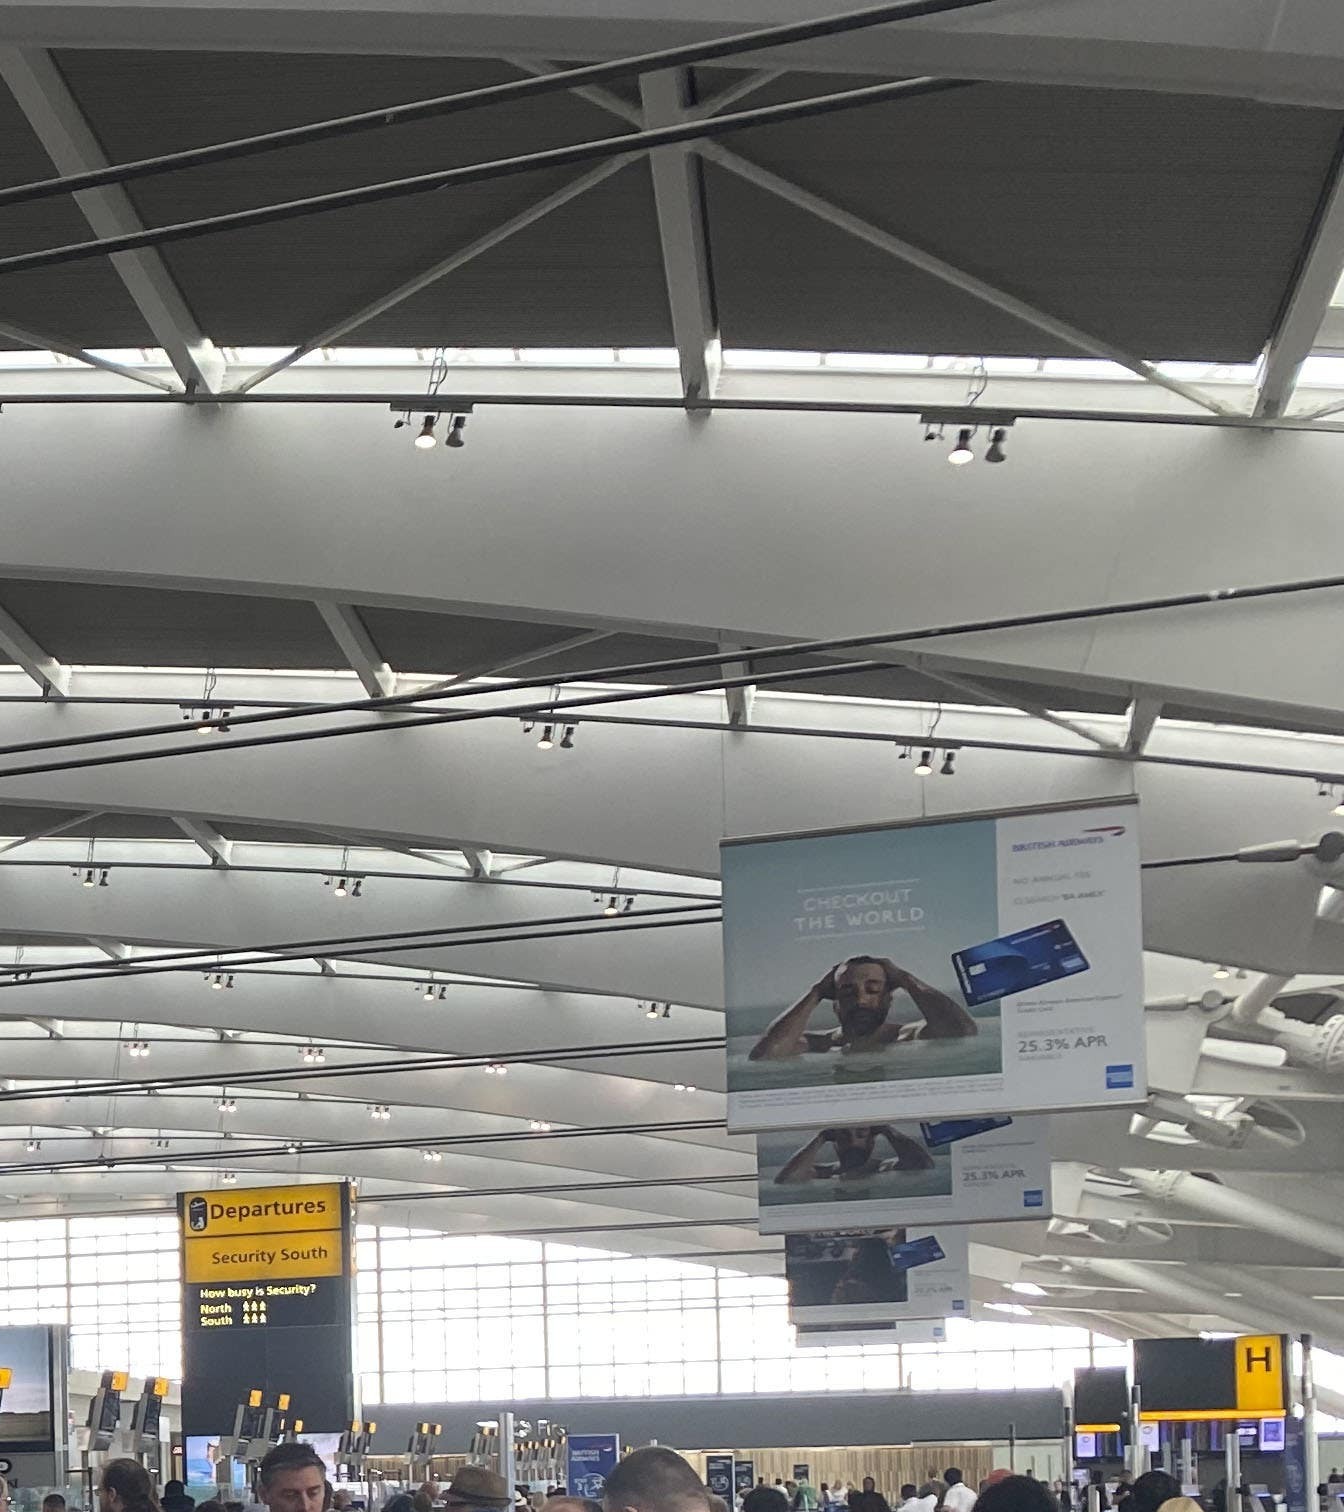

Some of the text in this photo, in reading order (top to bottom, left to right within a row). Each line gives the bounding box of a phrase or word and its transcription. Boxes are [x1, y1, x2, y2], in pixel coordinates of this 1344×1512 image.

[803, 888, 912, 911] CHECKOUT
[794, 907, 924, 931] THE WORLD
[1018, 1035, 1108, 1054] 25.3% APR
[210, 1200, 326, 1222] Departures
[212, 1246, 328, 1265] Security South
[200, 1283, 317, 1299] How busy is Security?
[200, 1303, 232, 1315] North
[200, 1316, 233, 1327] South
[1246, 1346, 1272, 1373] H
